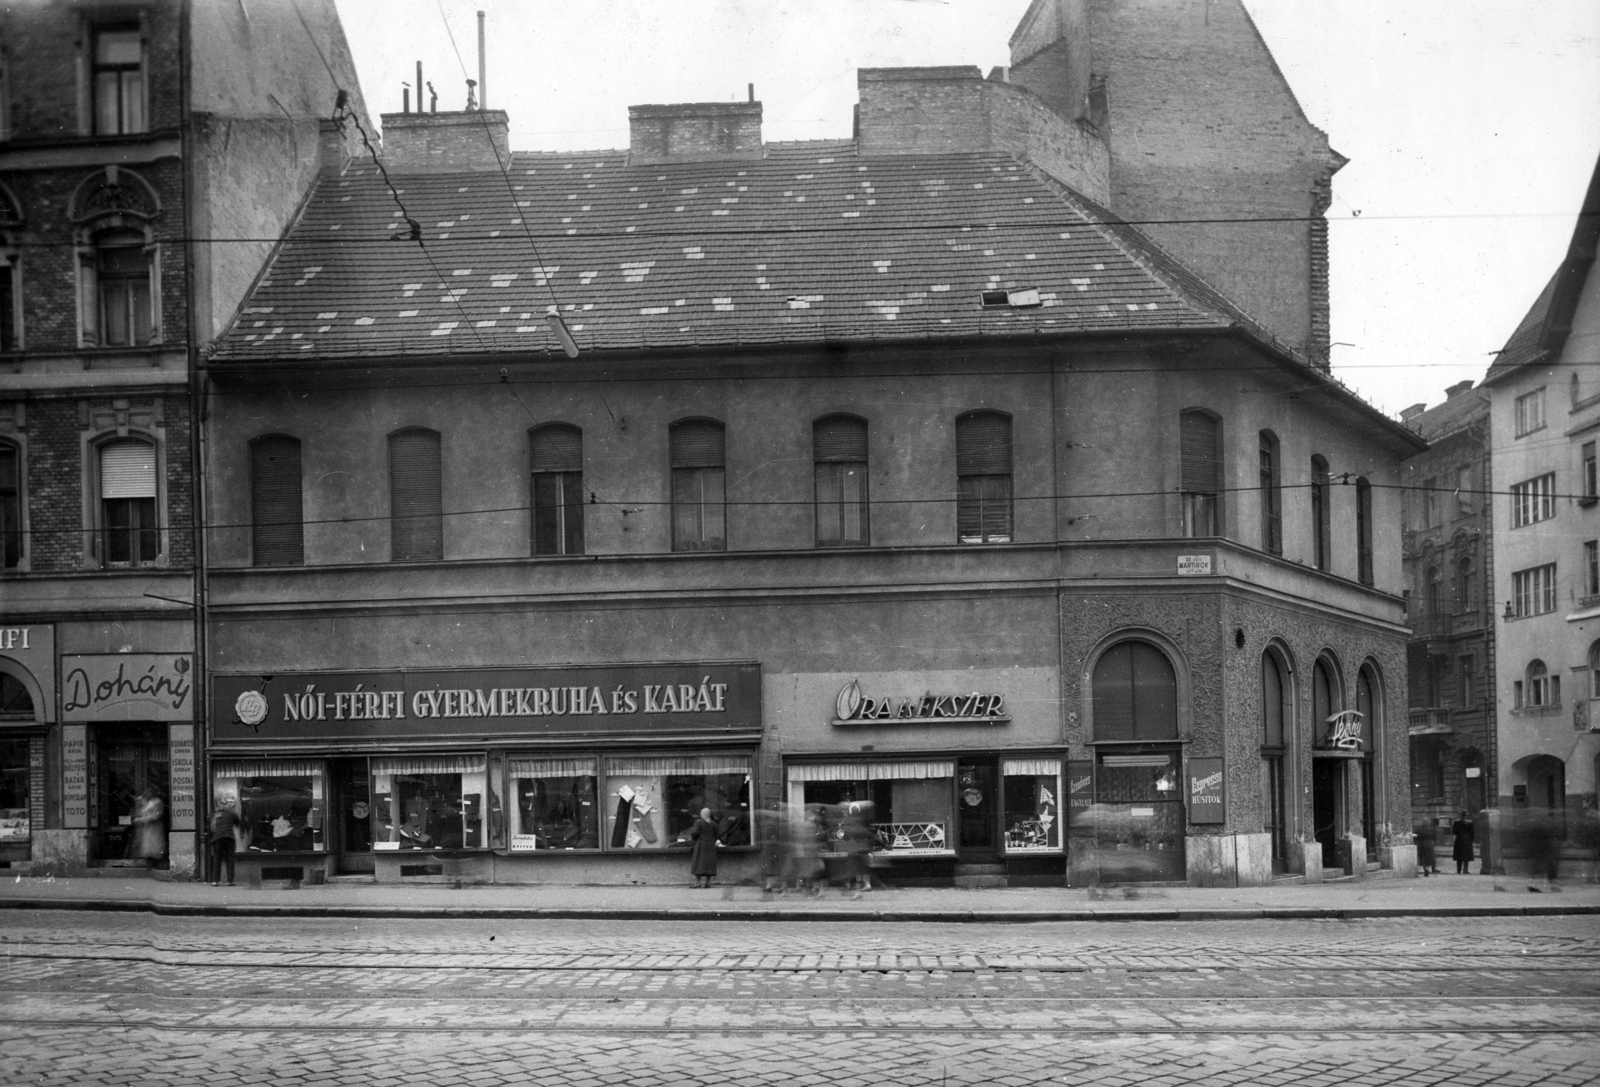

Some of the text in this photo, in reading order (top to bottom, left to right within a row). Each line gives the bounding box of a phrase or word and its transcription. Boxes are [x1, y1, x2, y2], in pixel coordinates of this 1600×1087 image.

[64, 662, 190, 712] Dohány
[283, 683, 406, 721] NŐI-FÉRFI
[412, 687, 608, 718] GYERMEKRUHA
[611, 684, 638, 714] ÉS
[643, 675, 728, 713] KABÁT
[172, 758, 193, 767] ISKOLA
[65, 807, 86, 816] TOTO
[172, 808, 194, 818] LOTTO
